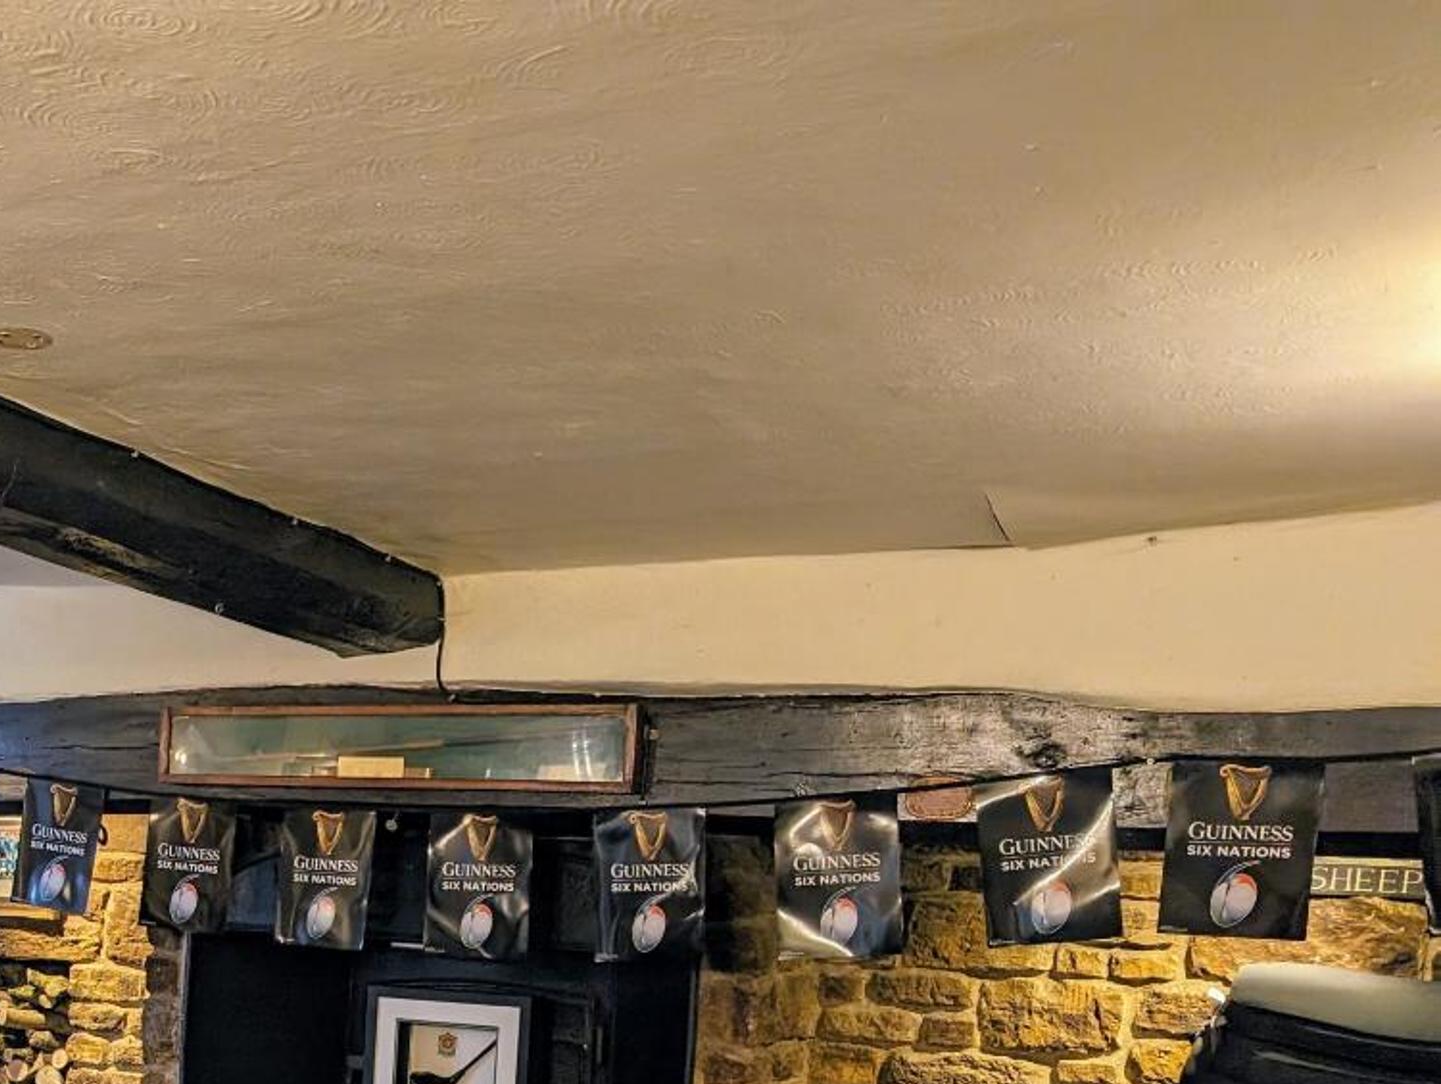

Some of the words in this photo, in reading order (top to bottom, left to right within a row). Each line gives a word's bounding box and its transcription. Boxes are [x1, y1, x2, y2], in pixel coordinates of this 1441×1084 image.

[32, 823, 88, 844] GUINNESS
[1188, 821, 1294, 843] GUINNESS
[157, 842, 220, 861] GUINNESS
[1187, 844, 1212, 857] SIX
[1217, 845, 1292, 859] NATIONS
[157, 860, 172, 870] SIX
[174, 862, 218, 874] NATIONS
[293, 856, 358, 873] GUINNESS
[441, 861, 517, 878] GUINNESS
[793, 852, 881, 871] GUINNESS
[1000, 859, 1024, 872] SIX
[1029, 852, 1097, 869] NATIS
[610, 863, 689, 879] GUINNESS
[794, 874, 817, 886] SIX
[820, 871, 881, 885] NATIONS
[1312, 866, 1423, 893] SHEEP
[293, 874, 309, 883] SIX
[311, 875, 357, 886] NATIONS
[442, 881, 460, 891] SIX
[463, 881, 514, 893] NATIONS
[610, 882, 631, 893] SIX
[634, 880, 689, 893] NATIONS
